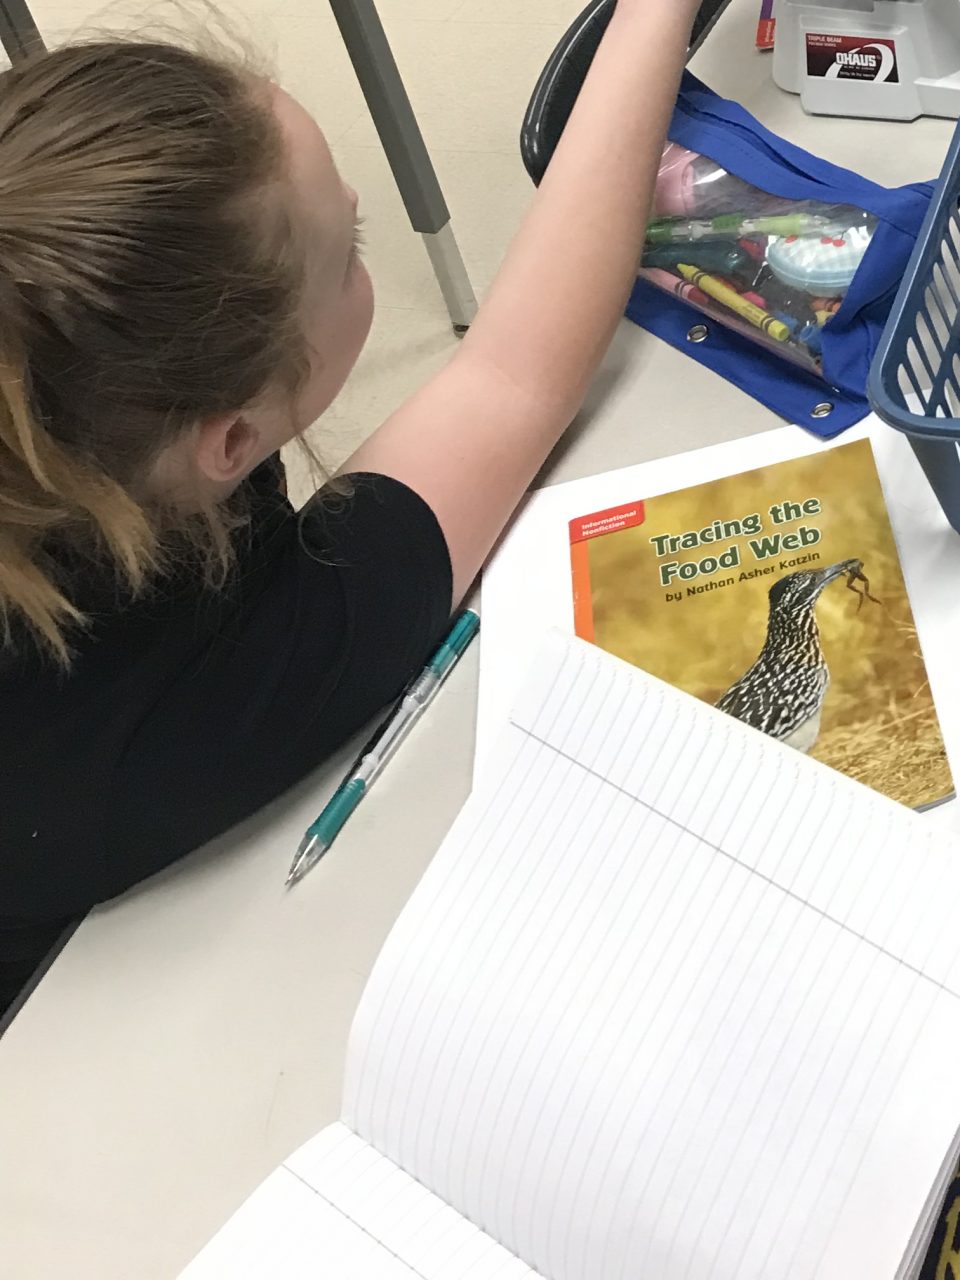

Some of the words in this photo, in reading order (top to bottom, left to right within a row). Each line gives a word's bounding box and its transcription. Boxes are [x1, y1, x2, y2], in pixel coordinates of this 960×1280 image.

[836, 52, 876, 67] OHAUS
[581, 510, 637, 530] Informational
[581, 520, 626, 537] Nonfiction
[650, 513, 761, 557] Tracing
[769, 497, 821, 524] the
[659, 545, 740, 586] Food
[749, 525, 821, 560] Web
[665, 591, 682, 602] by
[686, 577, 735, 597] Nathan
[738, 565, 775, 582] Asher
[779, 551, 820, 570] Katzin
